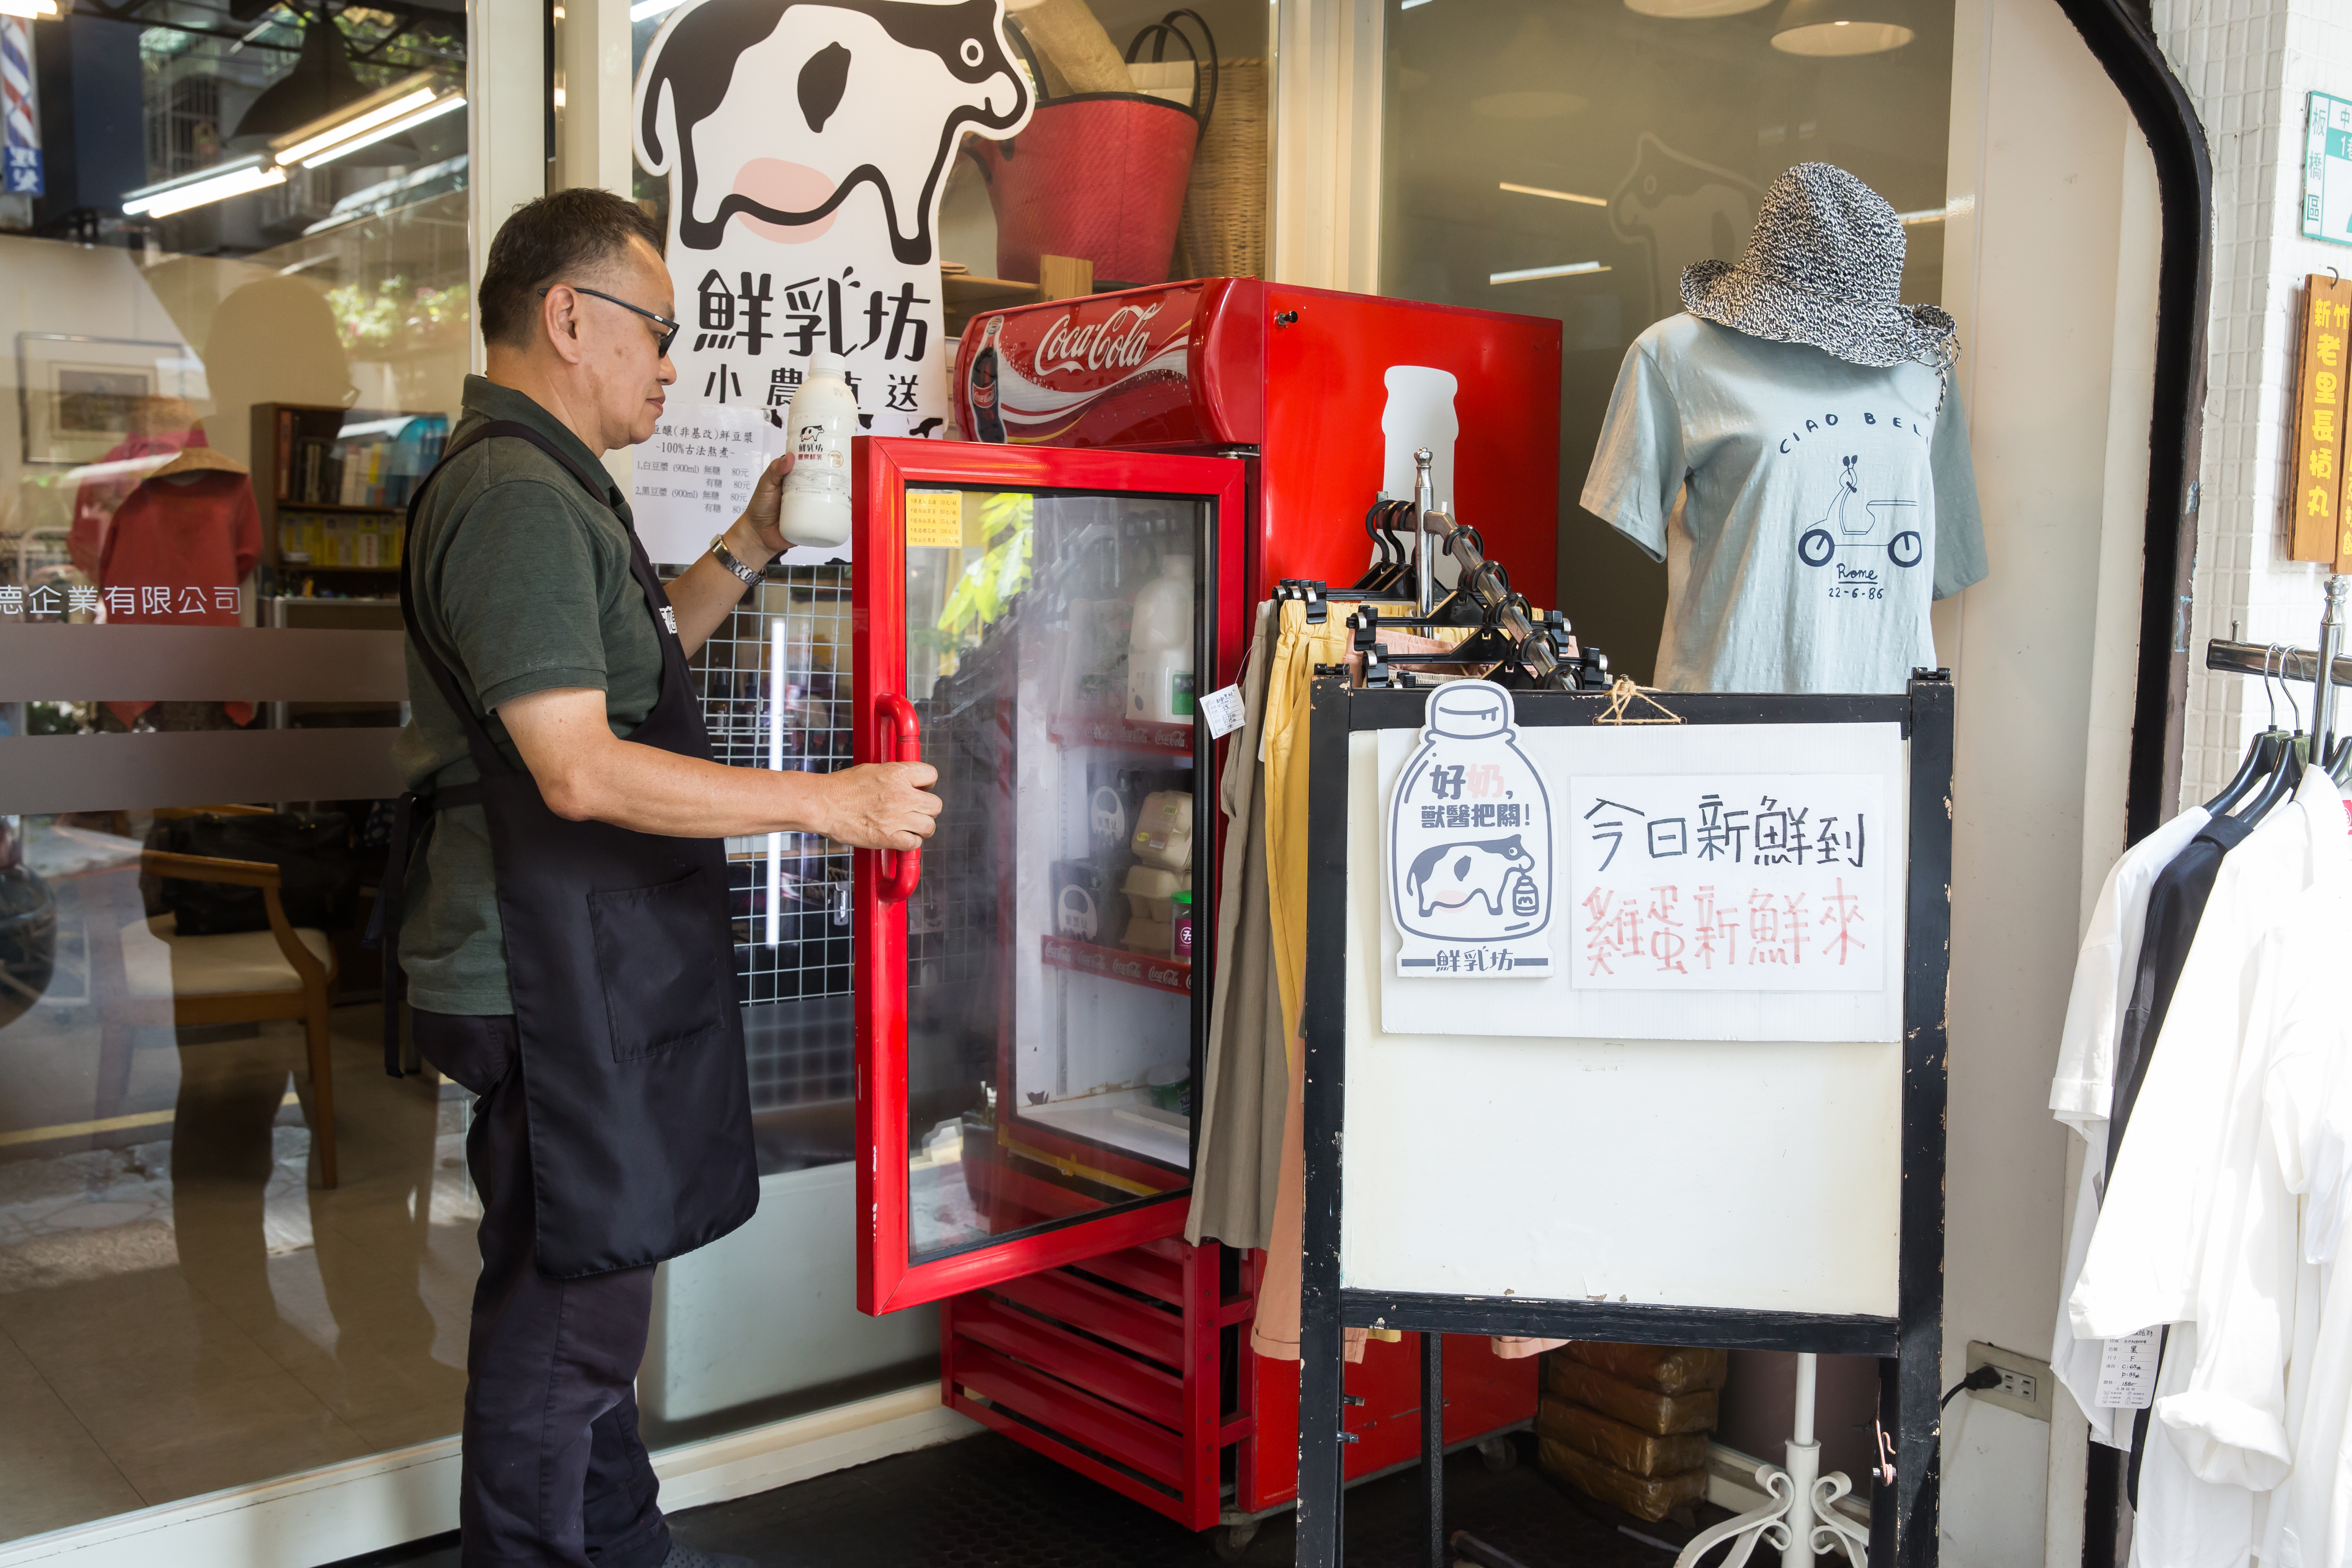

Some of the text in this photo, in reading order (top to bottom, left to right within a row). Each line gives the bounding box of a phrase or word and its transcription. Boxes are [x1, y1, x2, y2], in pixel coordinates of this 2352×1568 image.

[2306, 106, 2327, 222] 板橋區
[693, 266, 931, 362] 鮮乳坊
[2314, 298, 2350, 330] 新竹
[1034, 302, 1166, 376] Coca-Cola
[799, 443, 823, 452] 鮮乳坊
[1779, 413, 1838, 454] CIAO
[673, 464, 699, 474] (900ml)
[704, 465, 721, 475] 無糖
[731, 468, 749, 478] 80元
[706, 478, 750, 490] 有糖 80元
[672, 489, 698, 500] (900ml)
[702, 490, 719, 501] 無糖
[730, 493, 748, 502] 80元
[704, 503, 721, 514] 有糖
[1836, 563, 1878, 580] Rome
[1828, 587, 1884, 600] 22-6-86
[1429, 764, 1513, 800] 好奶,
[1421, 803, 1530, 829] 獸醫把關!
[1584, 793, 1864, 872] 今日新鮮到
[1582, 877, 1865, 977] 雞蛋新鮮來
[1435, 945, 1514, 973] 鮮乳坊
